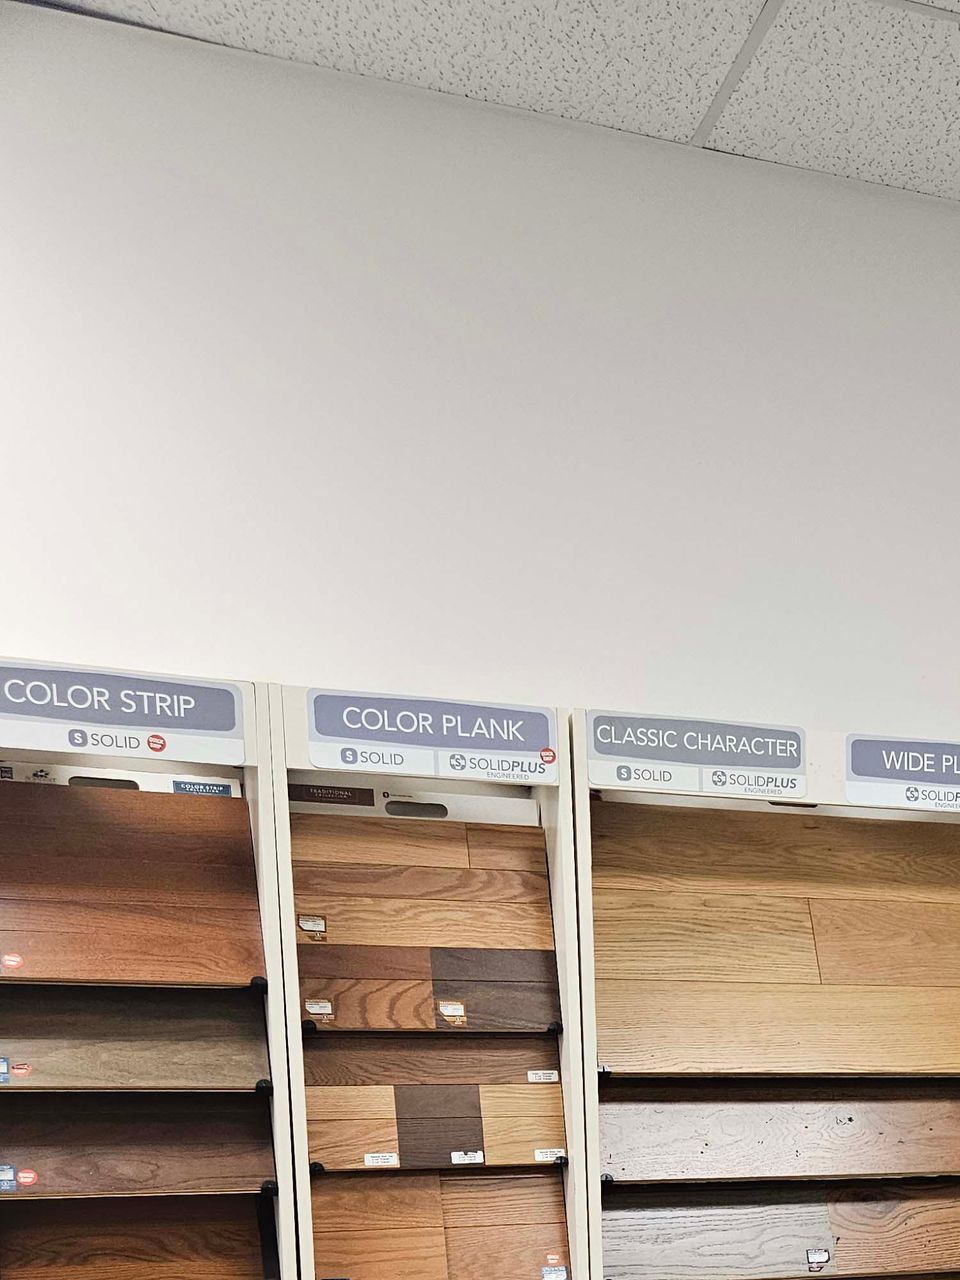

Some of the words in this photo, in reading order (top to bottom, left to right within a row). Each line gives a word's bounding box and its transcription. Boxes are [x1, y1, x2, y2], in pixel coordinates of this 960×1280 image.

[4, 679, 111, 711] COLOR
[120, 689, 195, 718] STRIP
[343, 706, 434, 734] COLOR
[443, 714, 525, 742] PLANK
[90, 733, 140, 749] SOLID
[596, 725, 677, 749] CLASSIC
[683, 732, 798, 757] CHARACTER
[360, 751, 404, 766] SOLID
[469, 757, 547, 774] SOLIDPLUS
[882, 750, 936, 773] WIDE
[486, 772, 529, 781] ENGINEERED
[633, 768, 672, 782] SOLID
[729, 773, 797, 789] SOLIDPLUS
